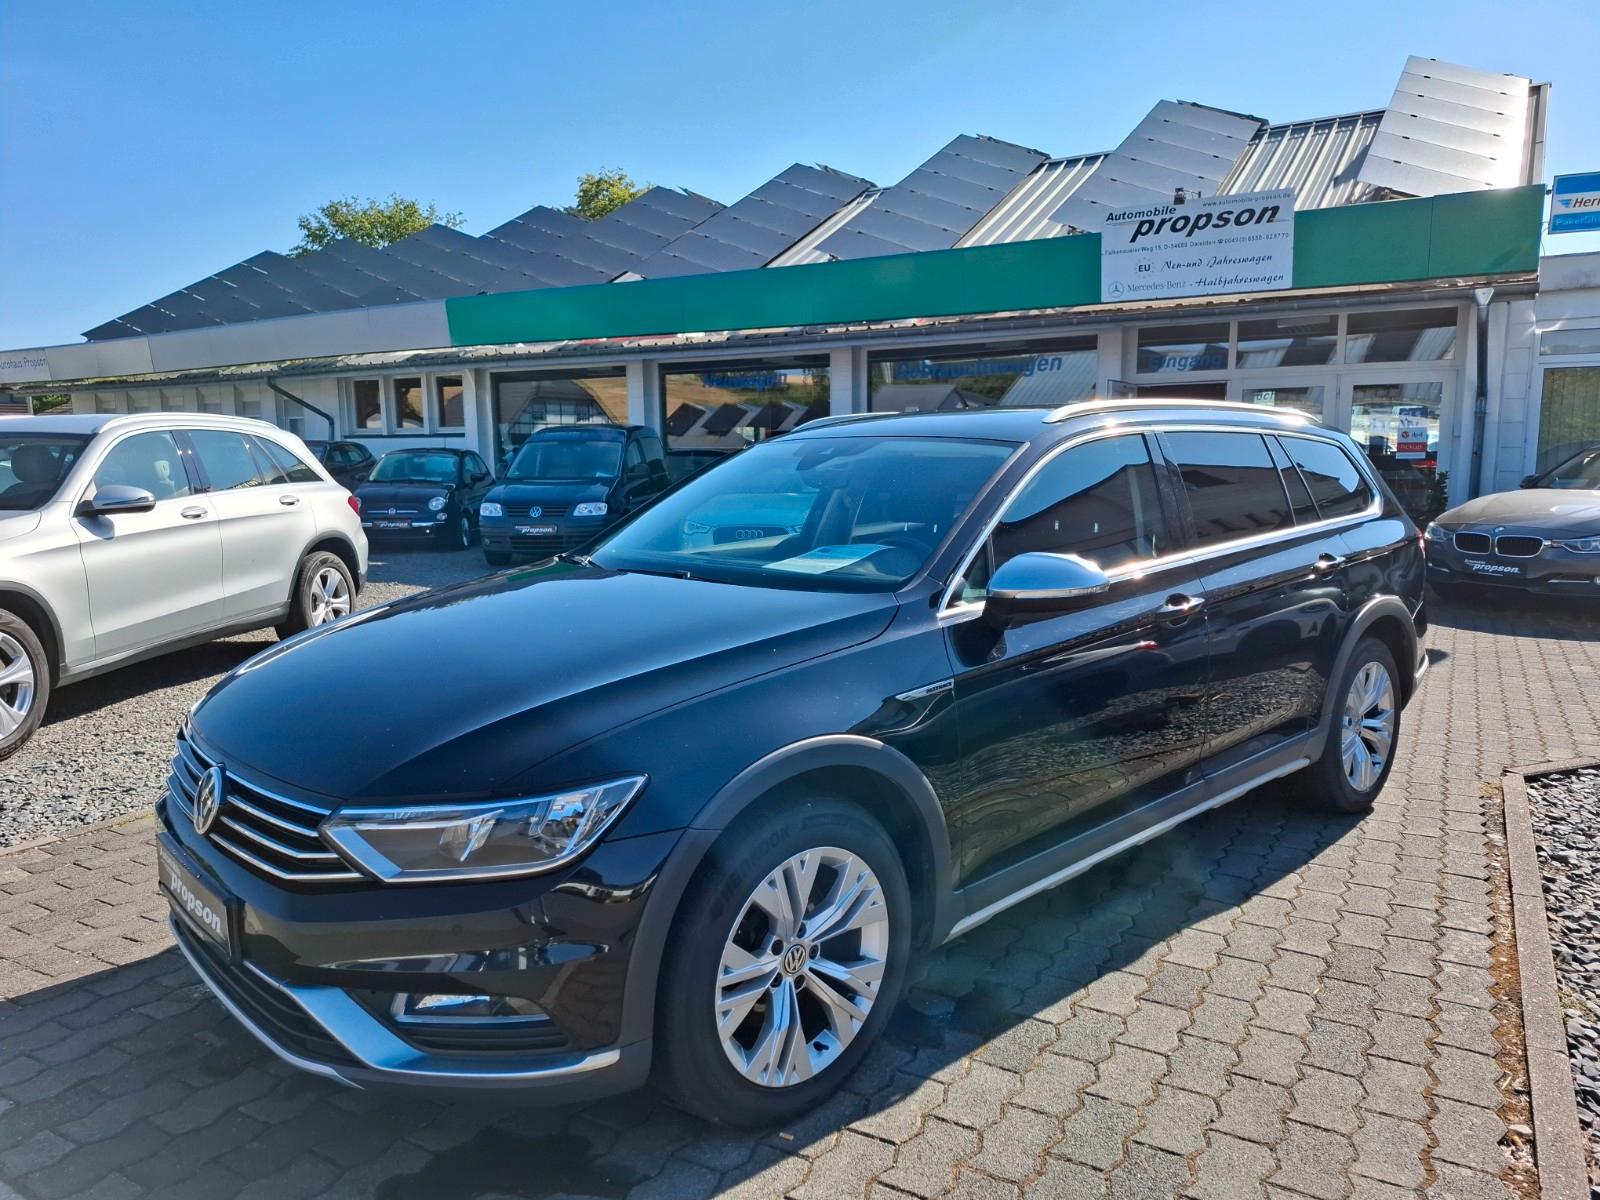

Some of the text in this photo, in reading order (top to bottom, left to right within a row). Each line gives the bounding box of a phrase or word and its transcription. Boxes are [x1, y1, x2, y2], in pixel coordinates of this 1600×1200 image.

[1106, 206, 1177, 222] Automobile
[1129, 205, 1281, 243] propson
[1138, 264, 1151, 273] EU
[1206, 254, 1272, 269] Jahreswagen
[170, 872, 221, 934] propson
